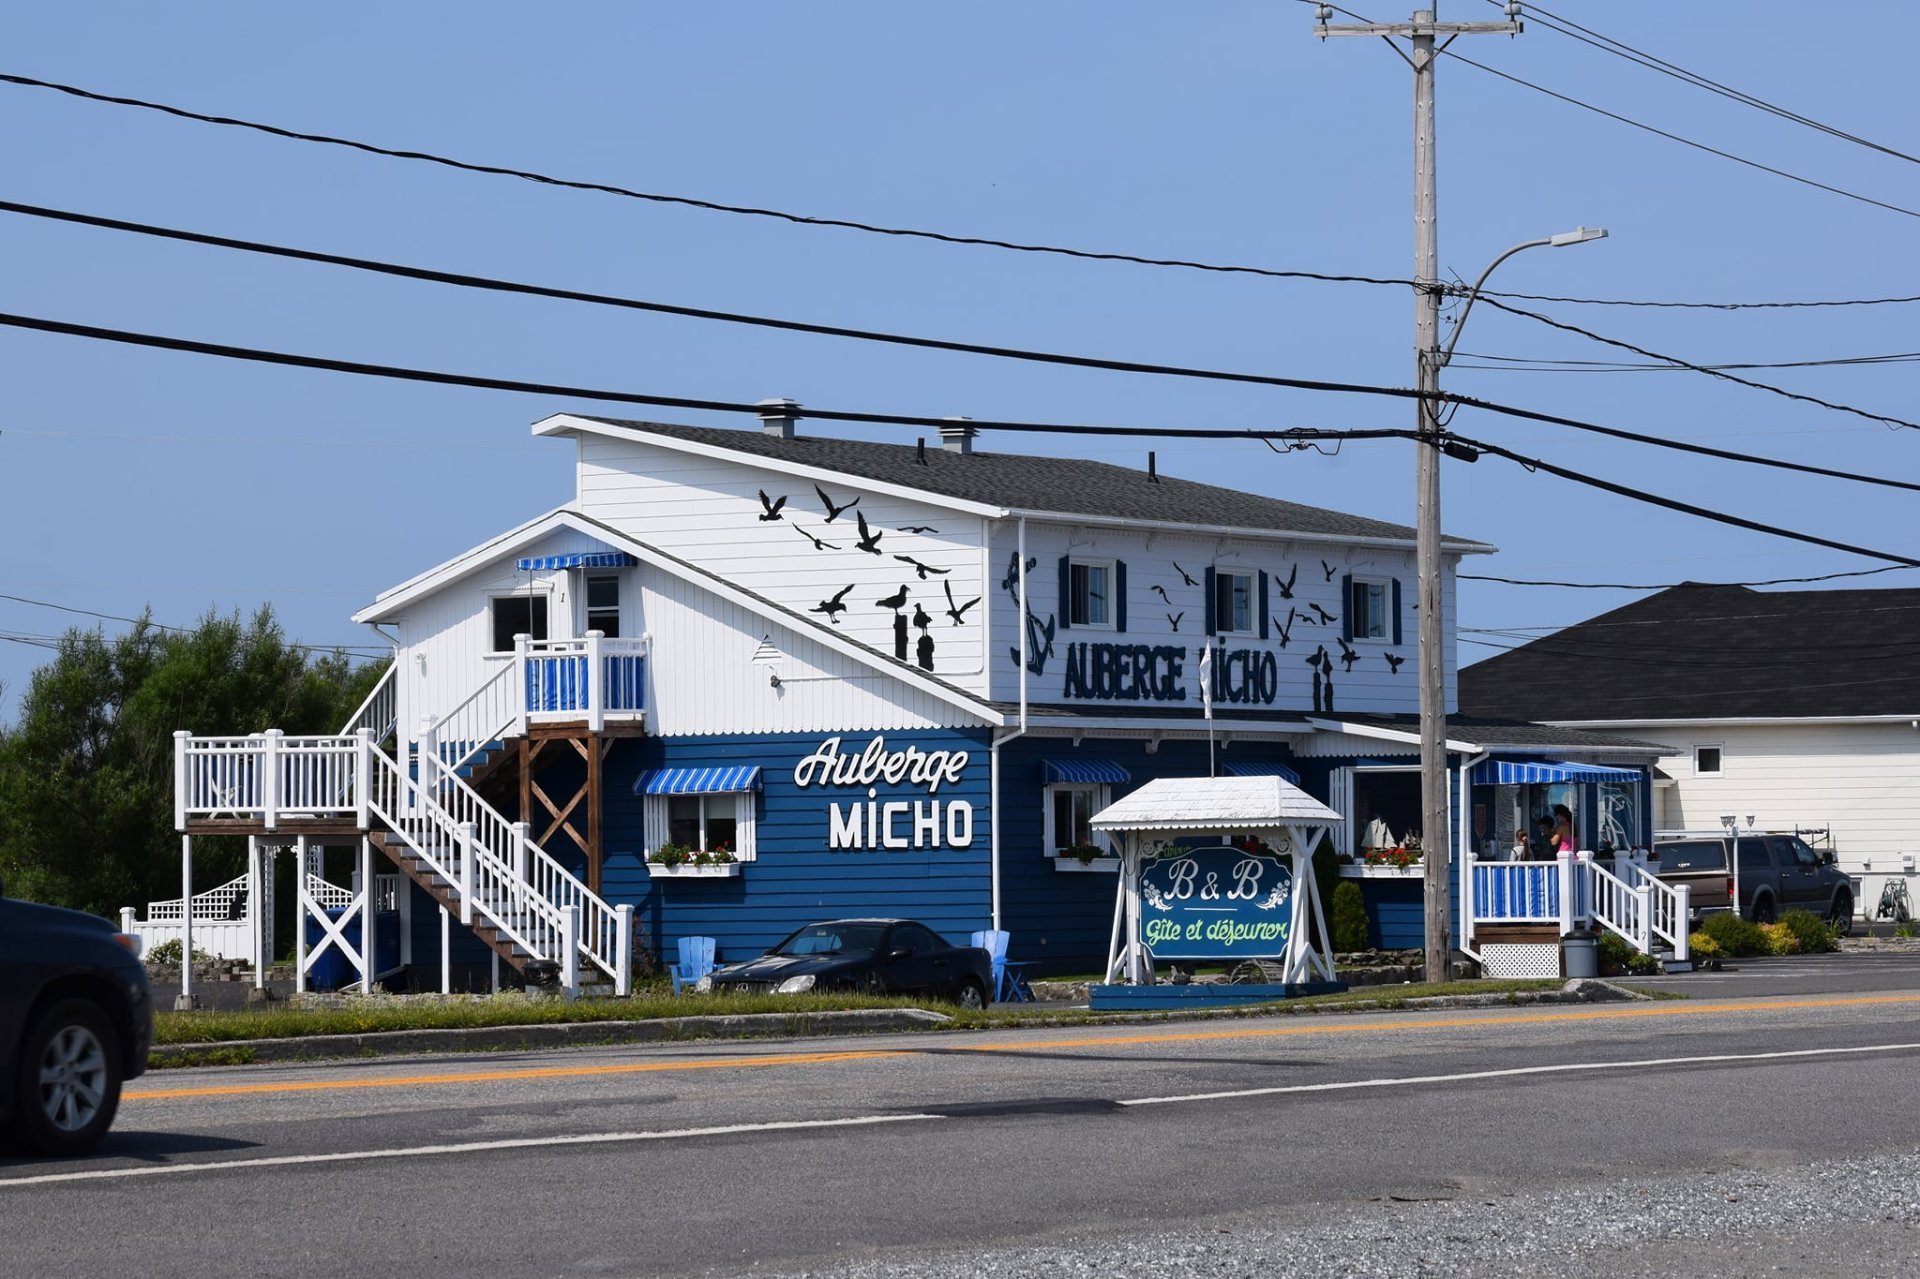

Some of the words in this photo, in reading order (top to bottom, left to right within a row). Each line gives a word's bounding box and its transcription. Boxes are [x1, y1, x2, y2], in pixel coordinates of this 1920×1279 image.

[1063, 642, 1187, 700] AUBERGE
[794, 735, 969, 793] Auberge
[1163, 858, 1199, 901] B
[1200, 871, 1220, 901] &
[1227, 858, 1264, 901] B
[1185, 918, 1204, 940] et
[1206, 918, 1288, 947] déjeuner
